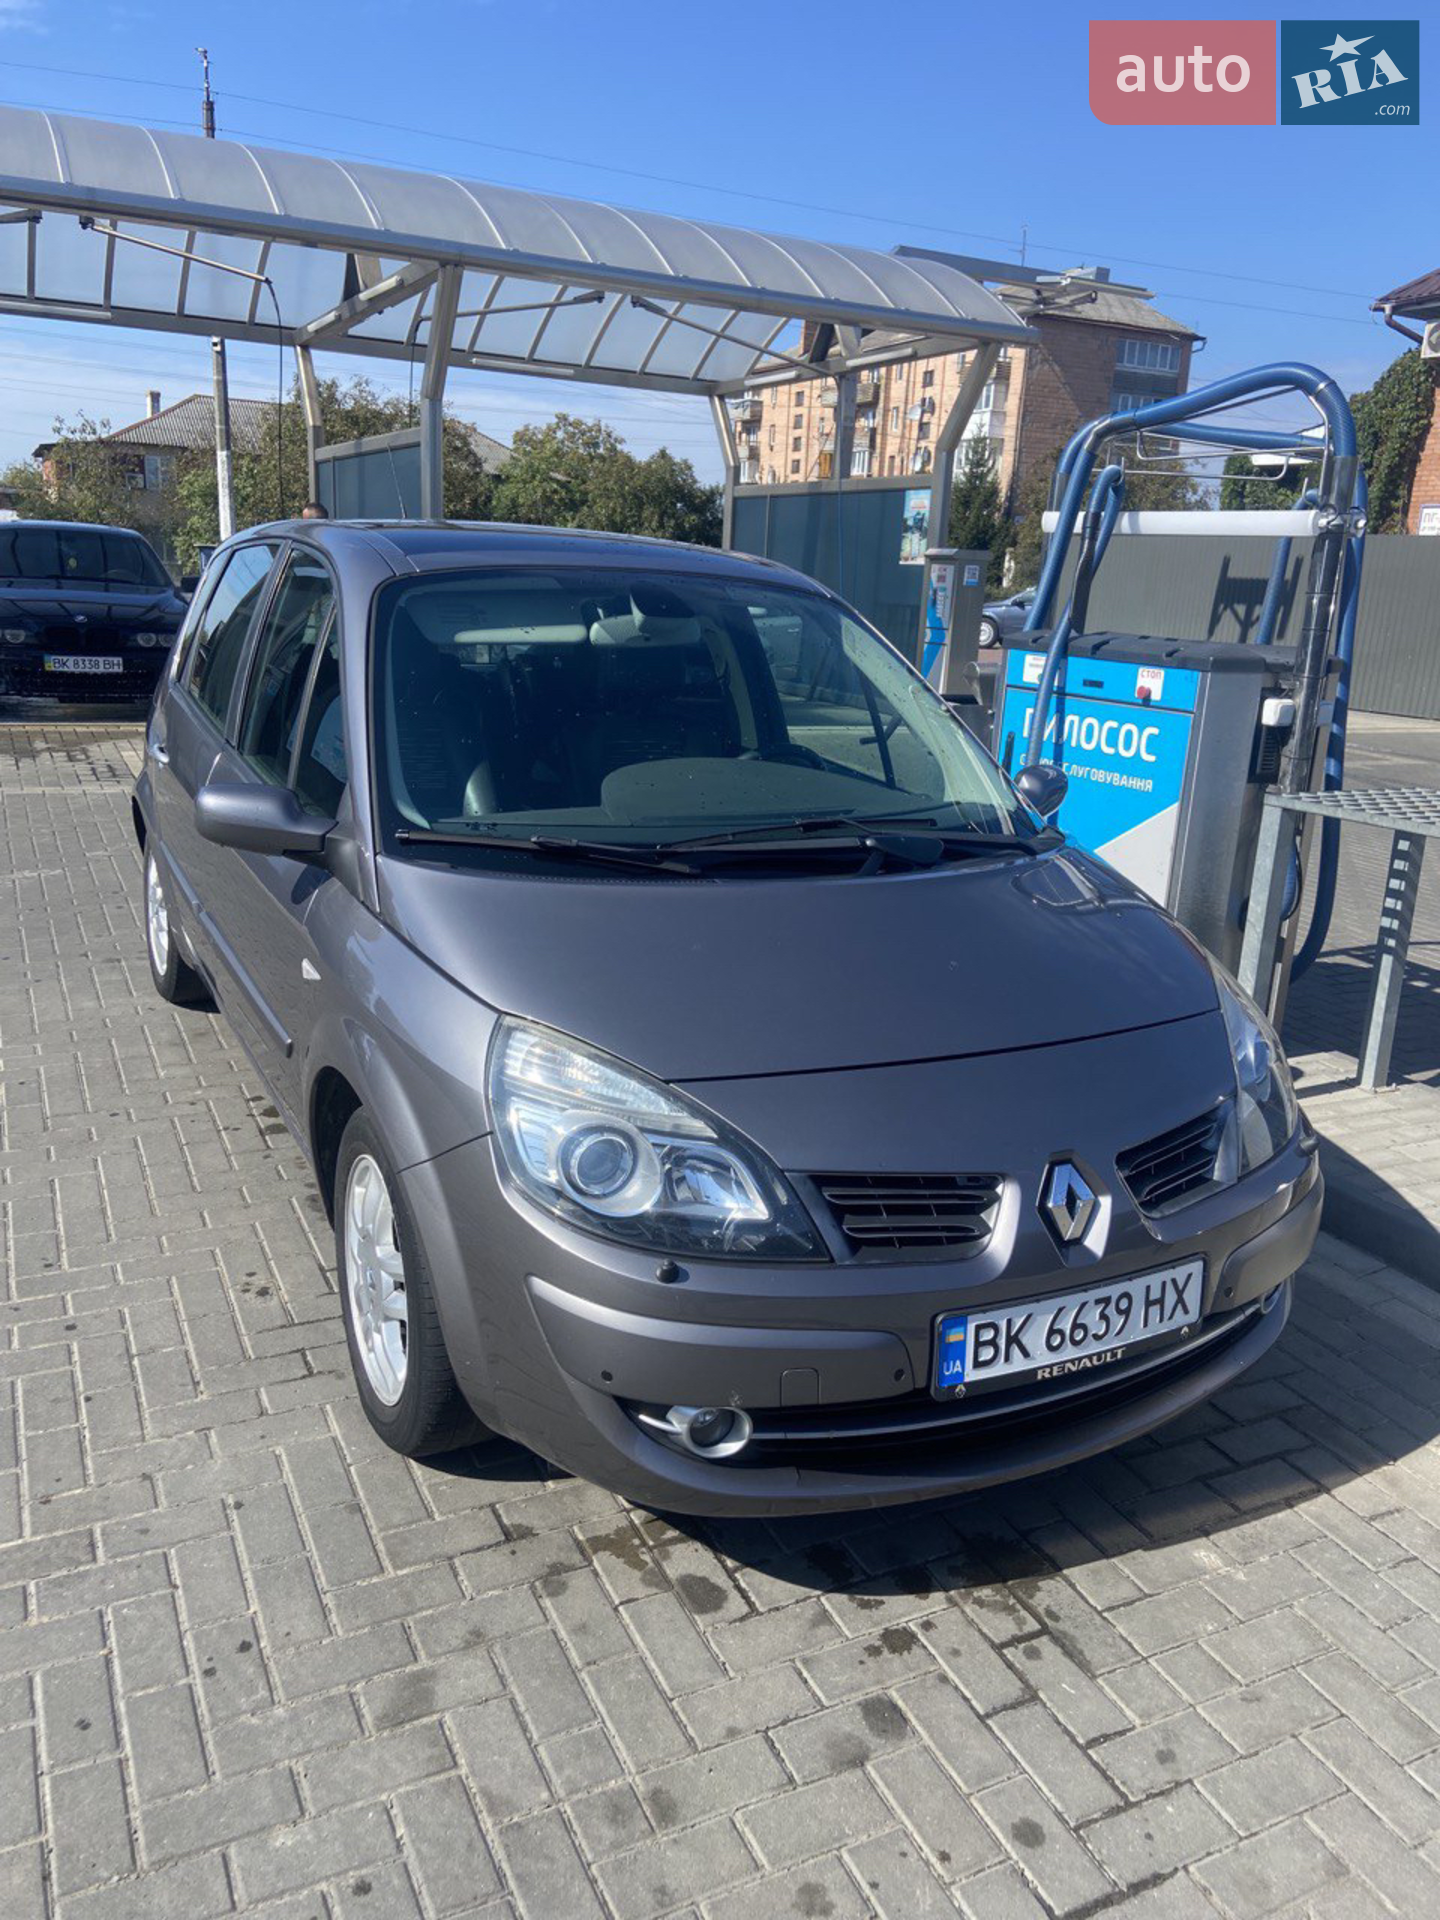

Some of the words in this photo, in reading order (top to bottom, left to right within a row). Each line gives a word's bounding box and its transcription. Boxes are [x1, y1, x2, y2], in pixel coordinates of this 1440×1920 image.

[53, 658, 70, 669] BK
[73, 659, 100, 670] 8338
[102, 659, 121, 670] BH
[1140, 669, 1162, 679] СТОП
[972, 1312, 1034, 1370] BK
[1044, 1291, 1133, 1352] 6639
[1141, 1273, 1193, 1329] HX
[943, 1361, 963, 1376] UA
[1036, 1347, 1126, 1380] RENAULT
